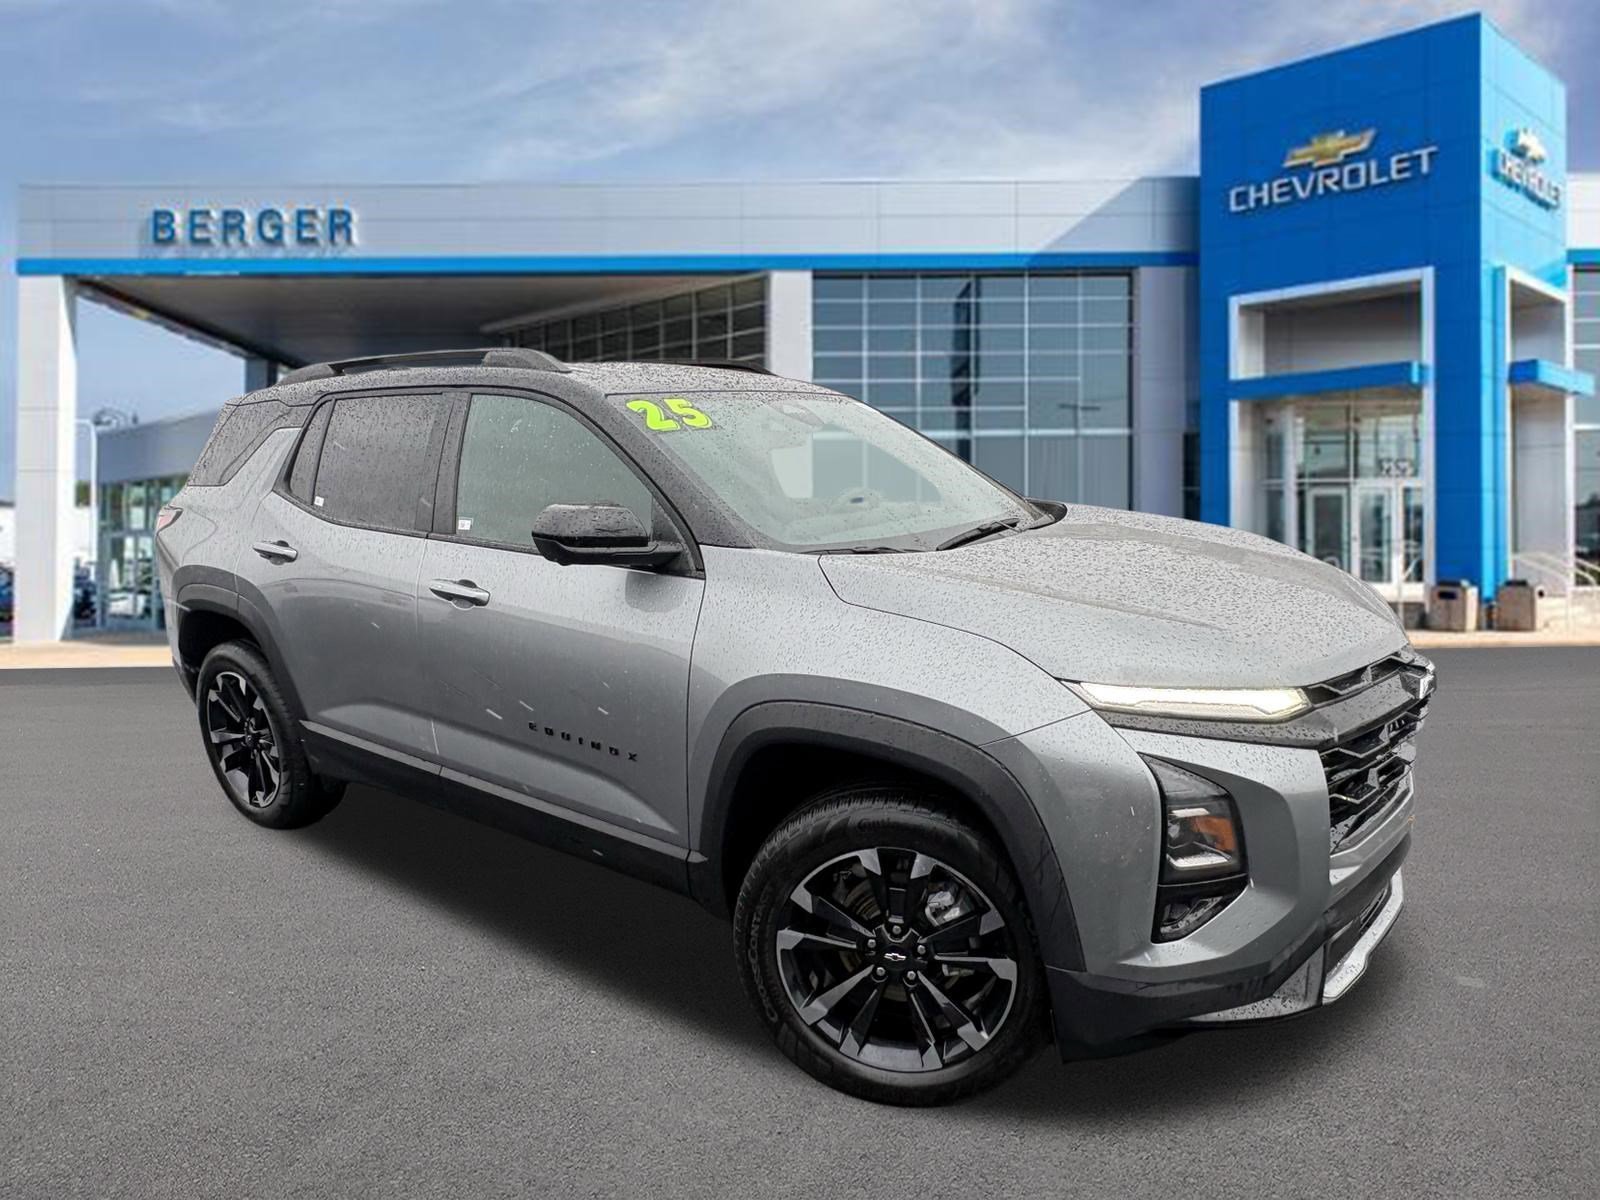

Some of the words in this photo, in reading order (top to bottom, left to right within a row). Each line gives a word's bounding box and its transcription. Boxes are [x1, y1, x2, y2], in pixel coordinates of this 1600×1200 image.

[1229, 146, 1438, 213] CHEVROLET
[152, 208, 357, 246] BERGER
[626, 397, 713, 432] 25
[528, 721, 637, 762] EQUINOX
